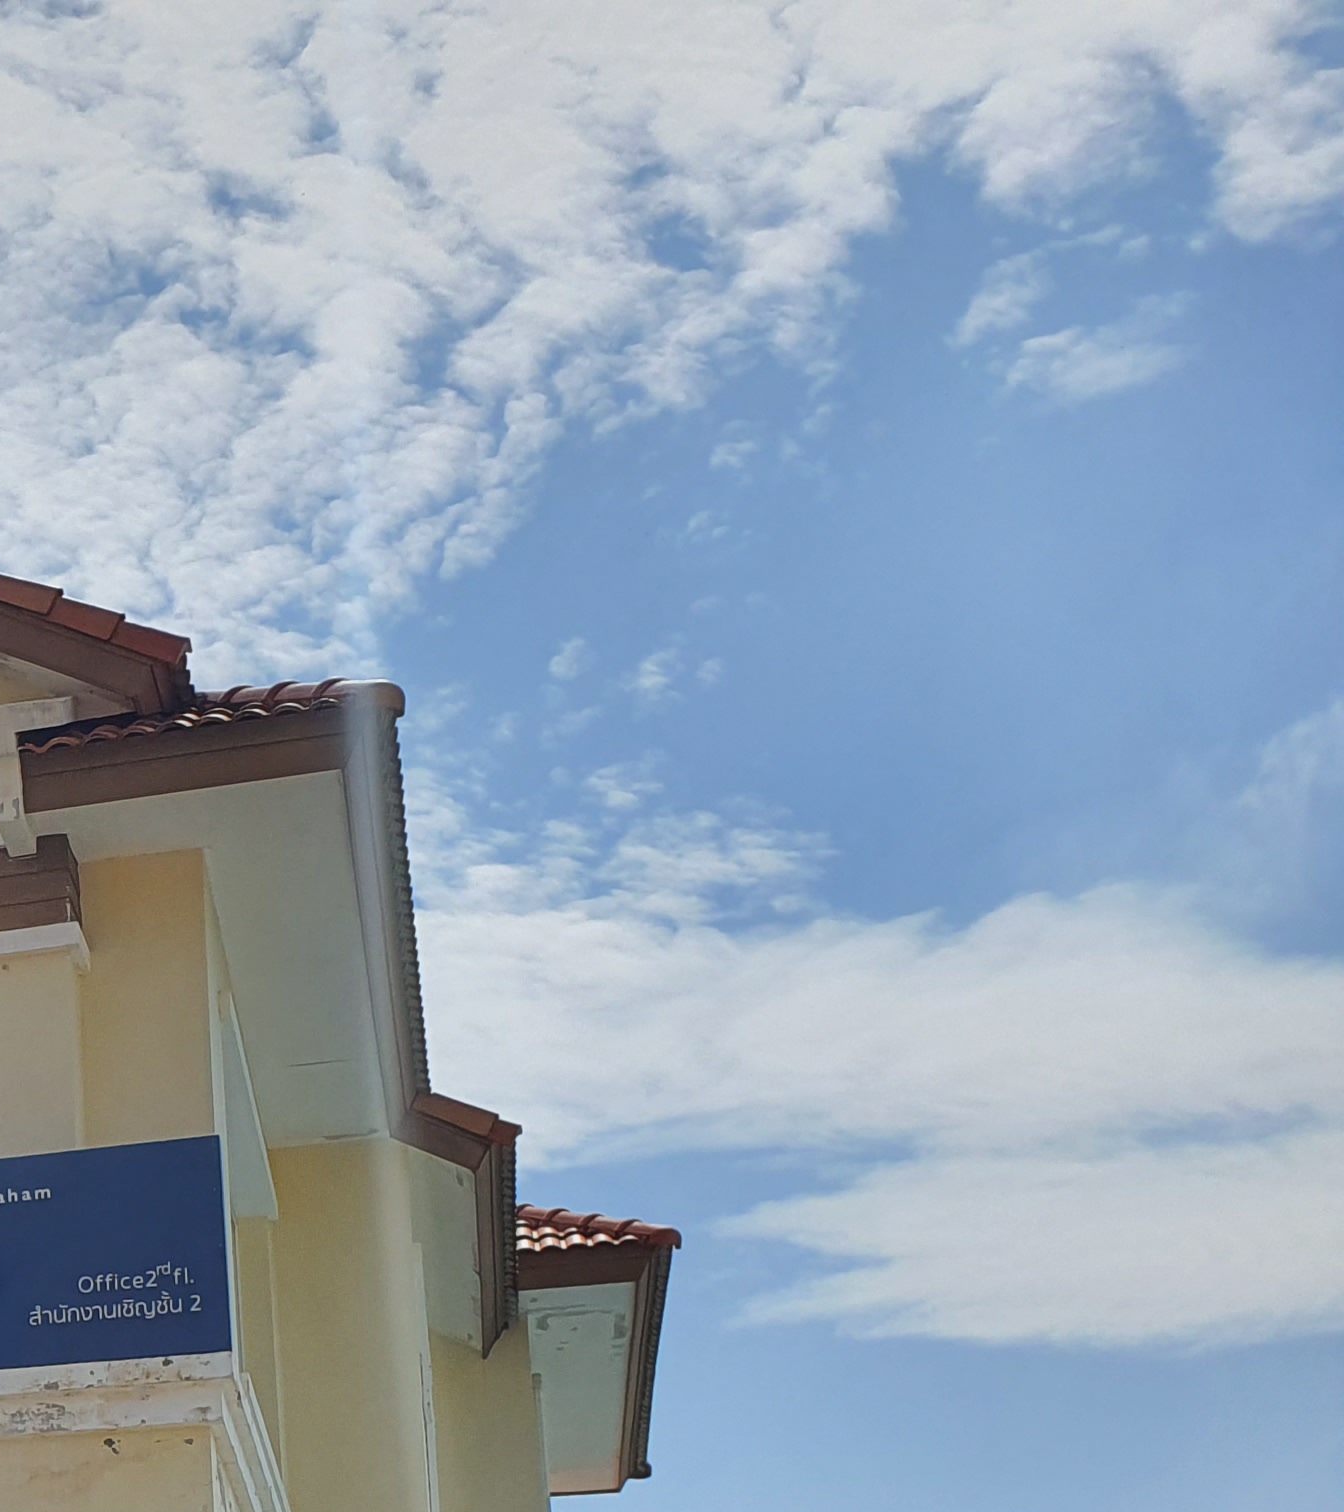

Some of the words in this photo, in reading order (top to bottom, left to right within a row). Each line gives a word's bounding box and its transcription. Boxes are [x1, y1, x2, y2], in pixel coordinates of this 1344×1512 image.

[29, 1291, 182, 1326] สำนักงานเชิญชั้น
[189, 1294, 202, 1312] 2
